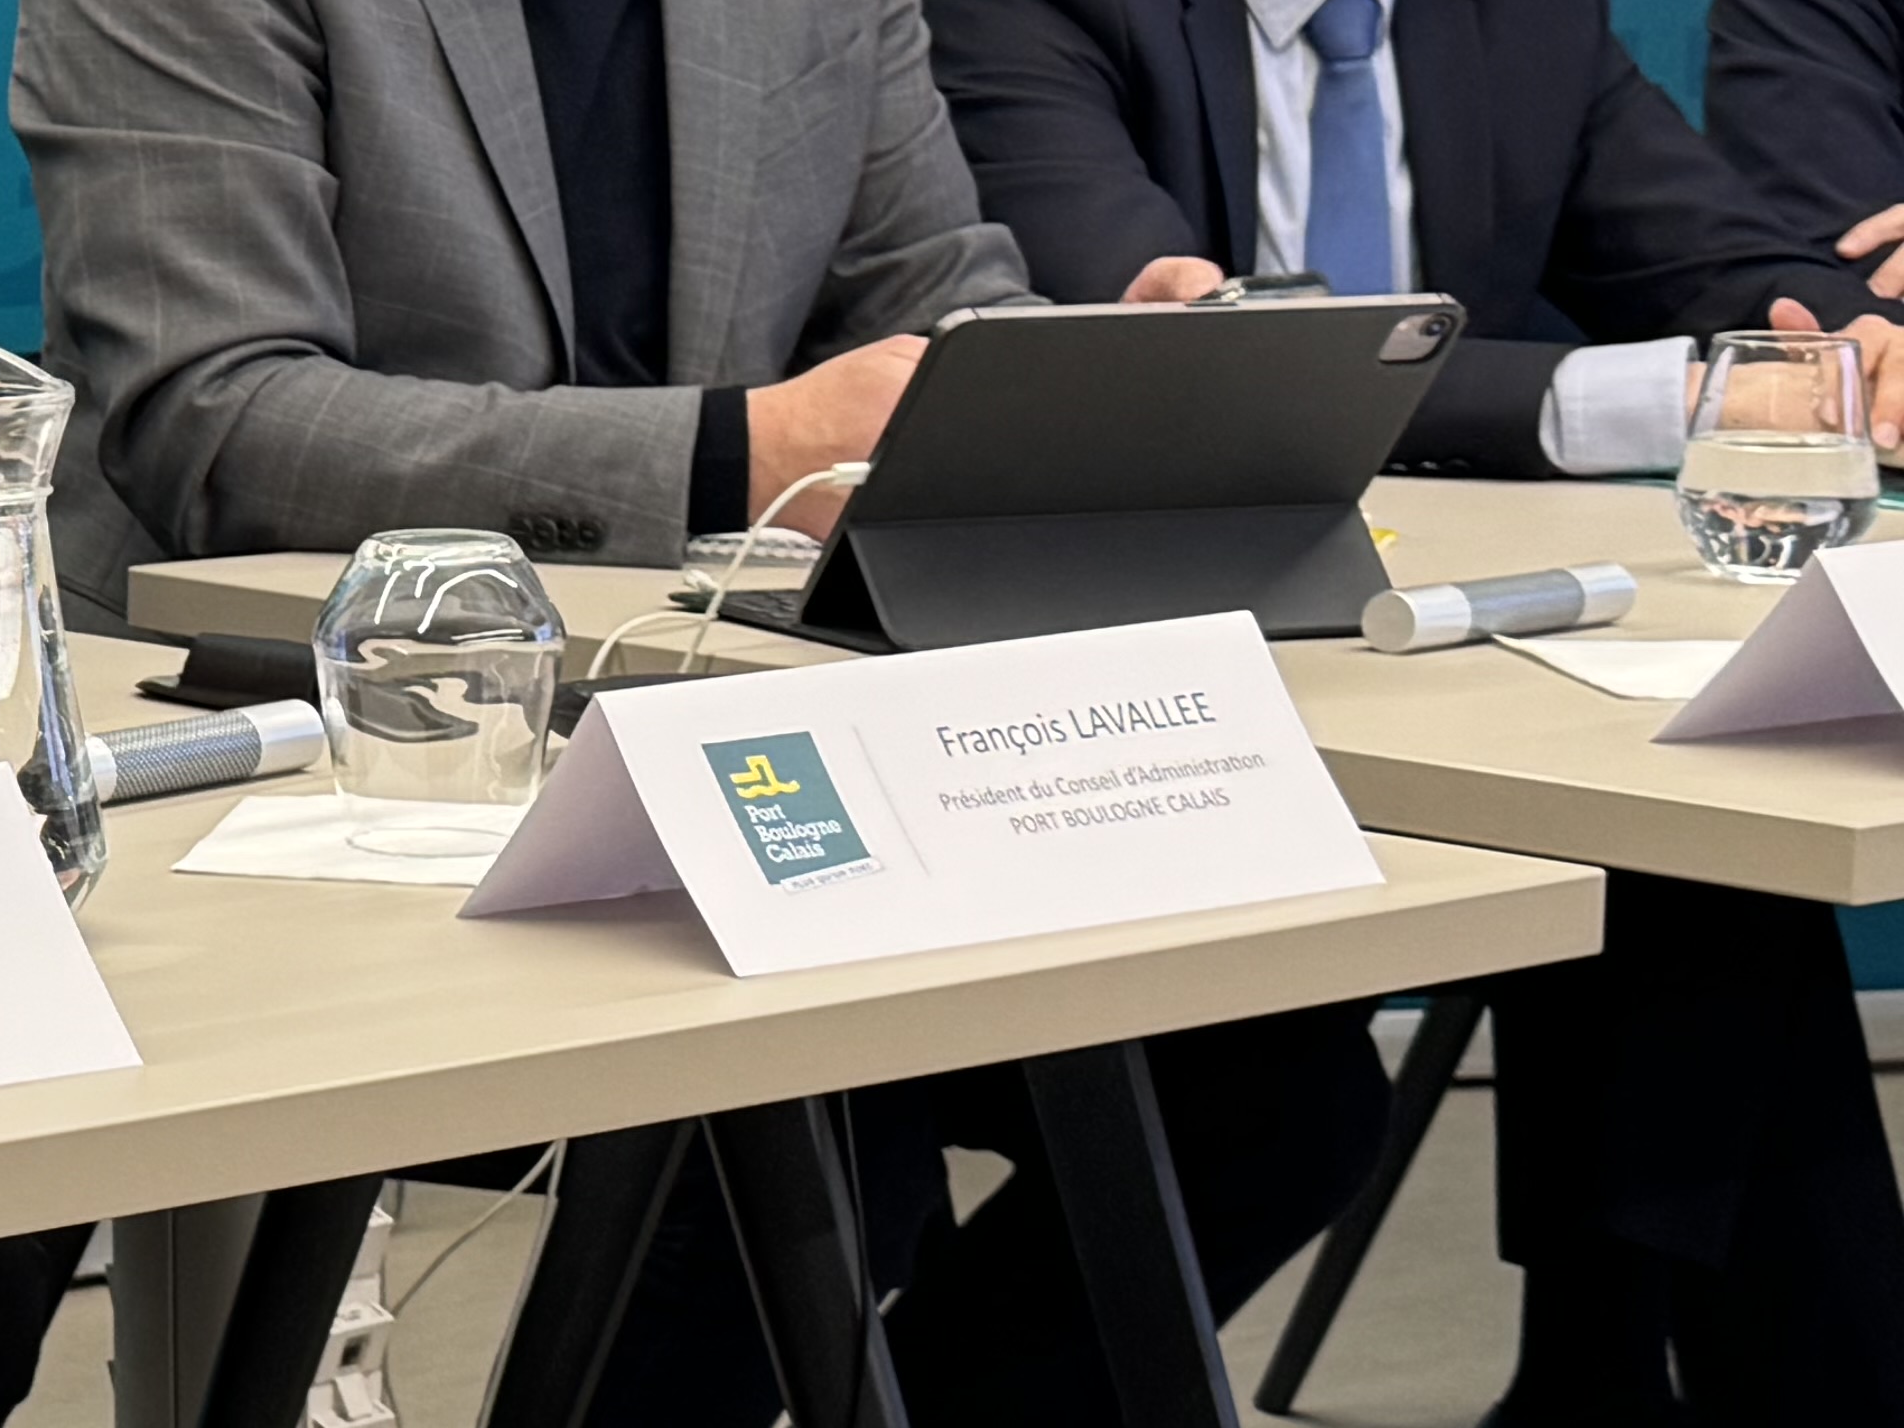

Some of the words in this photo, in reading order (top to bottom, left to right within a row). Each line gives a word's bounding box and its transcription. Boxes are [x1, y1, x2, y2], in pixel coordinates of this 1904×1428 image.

[936, 714, 1067, 756] François
[1068, 693, 1216, 738] LAVALLEE
[939, 786, 1027, 811] Président
[1029, 780, 1055, 799] du
[1055, 769, 1122, 795] Conseil
[744, 804, 786, 823] Port
[1009, 812, 1059, 834] PORT
[1061, 797, 1166, 827] BOULOGNE
[1167, 788, 1230, 812] CALAIS
[754, 820, 842, 842] Boulogne
[766, 841, 826, 862] Calais
